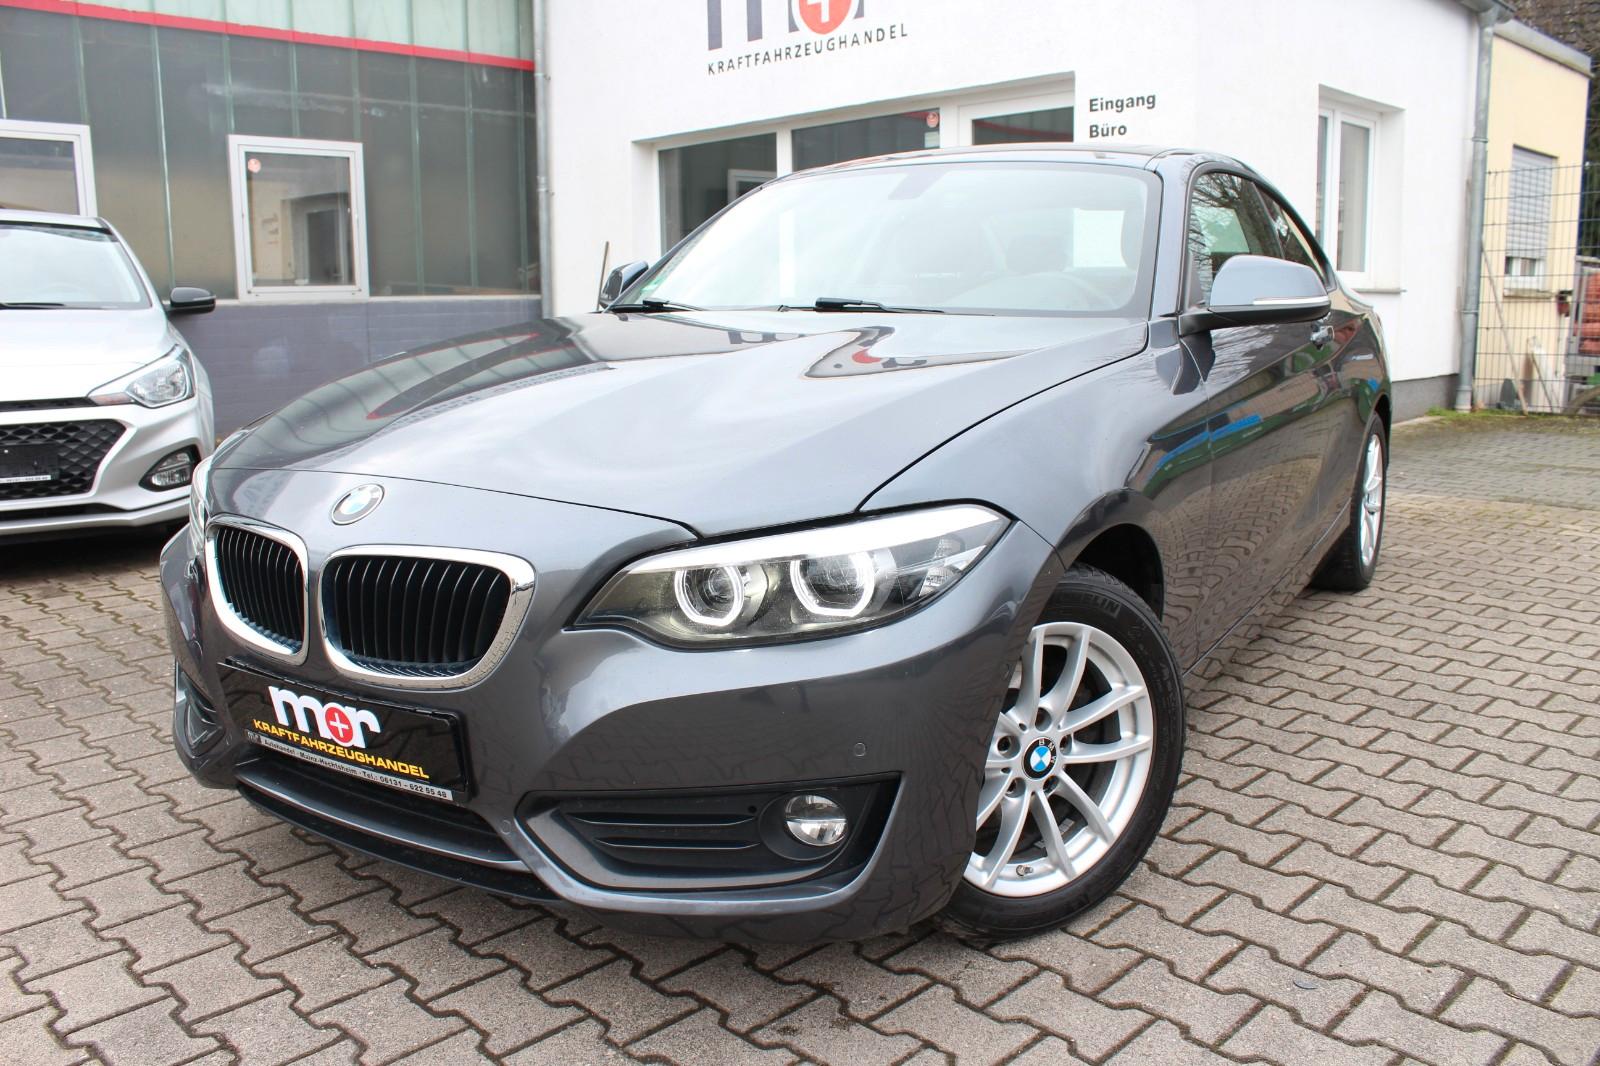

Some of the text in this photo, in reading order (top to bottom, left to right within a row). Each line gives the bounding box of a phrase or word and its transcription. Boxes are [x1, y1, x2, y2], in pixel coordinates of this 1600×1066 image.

[707, 23, 908, 76] KRAFTFAHRZEUGHANDEL
[1089, 94, 1156, 113] Eingang
[1089, 123, 1127, 138] Büro
[252, 718, 430, 779] KRAFTFAHRZEUGHANDEL
[409, 783, 424, 792] 622
